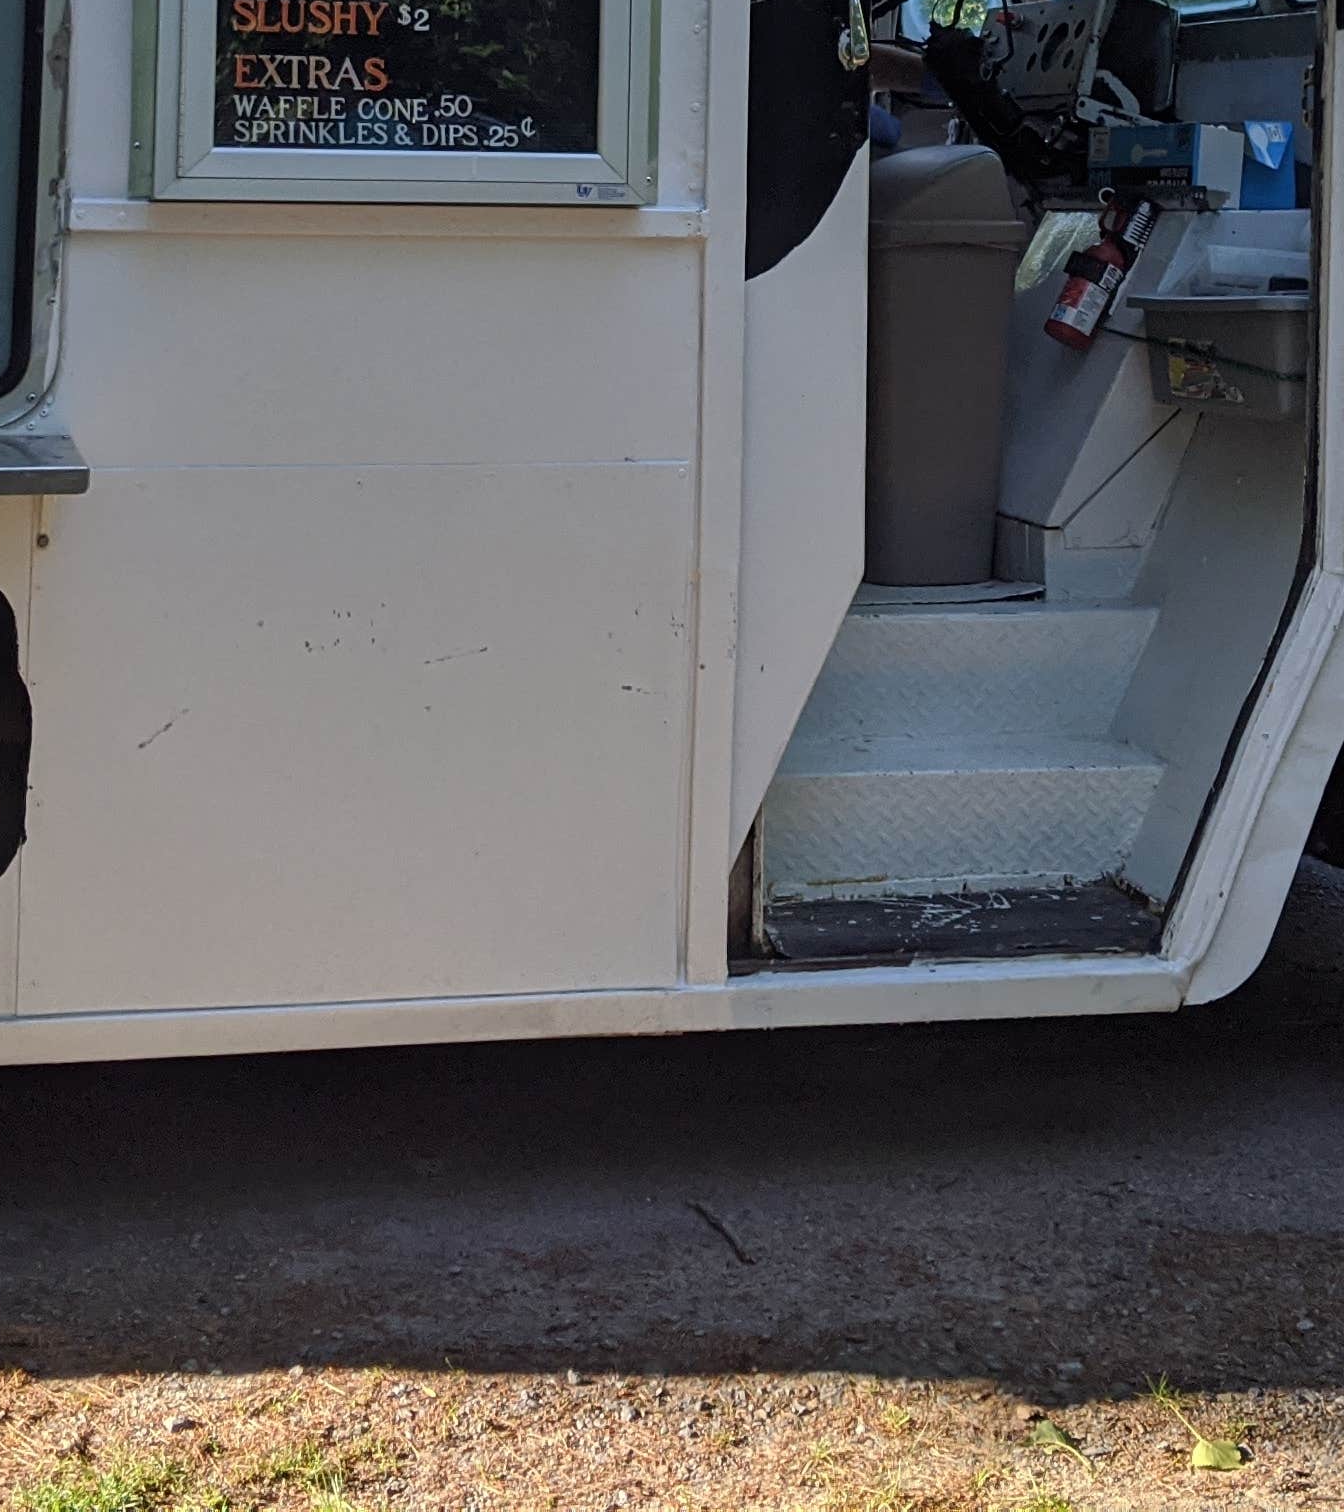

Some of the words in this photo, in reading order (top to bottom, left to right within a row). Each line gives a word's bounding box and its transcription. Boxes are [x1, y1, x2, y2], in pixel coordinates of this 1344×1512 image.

[397, 4, 430, 32] $2
[233, 54, 389, 92] EXTRAS
[233, 95, 346, 120] WAFFLE
[357, 98, 429, 122] CONE
[434, 95, 472, 118] .50
[233, 120, 387, 145] SPRINKLES
[394, 125, 413, 146] &
[422, 125, 479, 146] DIPS
